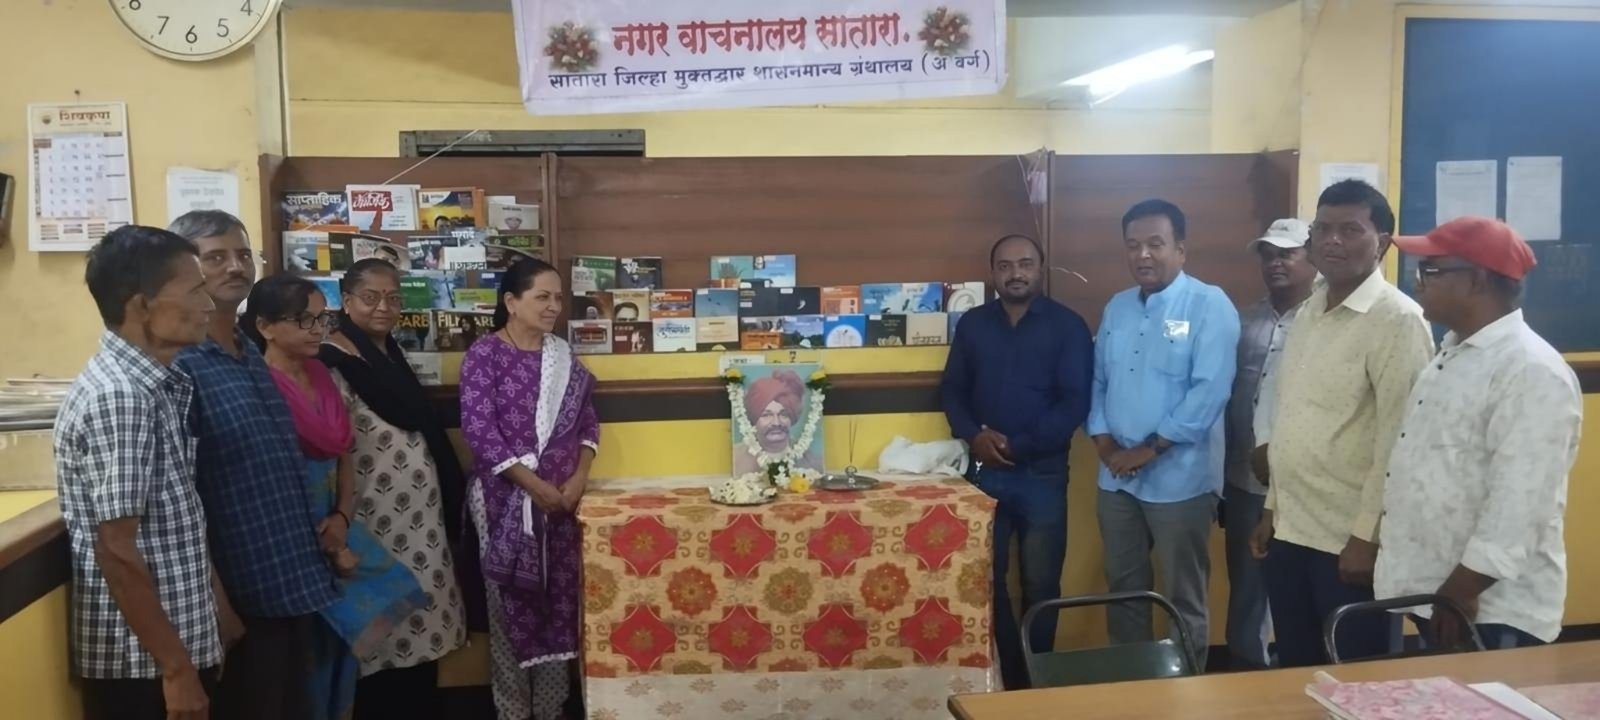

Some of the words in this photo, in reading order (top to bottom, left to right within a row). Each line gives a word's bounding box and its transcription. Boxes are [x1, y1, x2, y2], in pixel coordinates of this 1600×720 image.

[240, 0, 254, 16] 4
[156, 15, 170, 35] 7
[185, 25, 198, 44] 6
[216, 18, 230, 38] 5
[611, 22, 671, 57] नगर
[676, 16, 807, 55] वाचनालय
[814, 13, 910, 49] सातारा.
[548, 71, 607, 90] सातारा
[614, 66, 667, 87] जिल्हा
[673, 66, 746, 90] मुक्तद्वार
[753, 62, 842, 81] शासनमान्य
[850, 56, 913, 78] ग्रंथालय
[285, 191, 342, 206] साप्ताहिक
